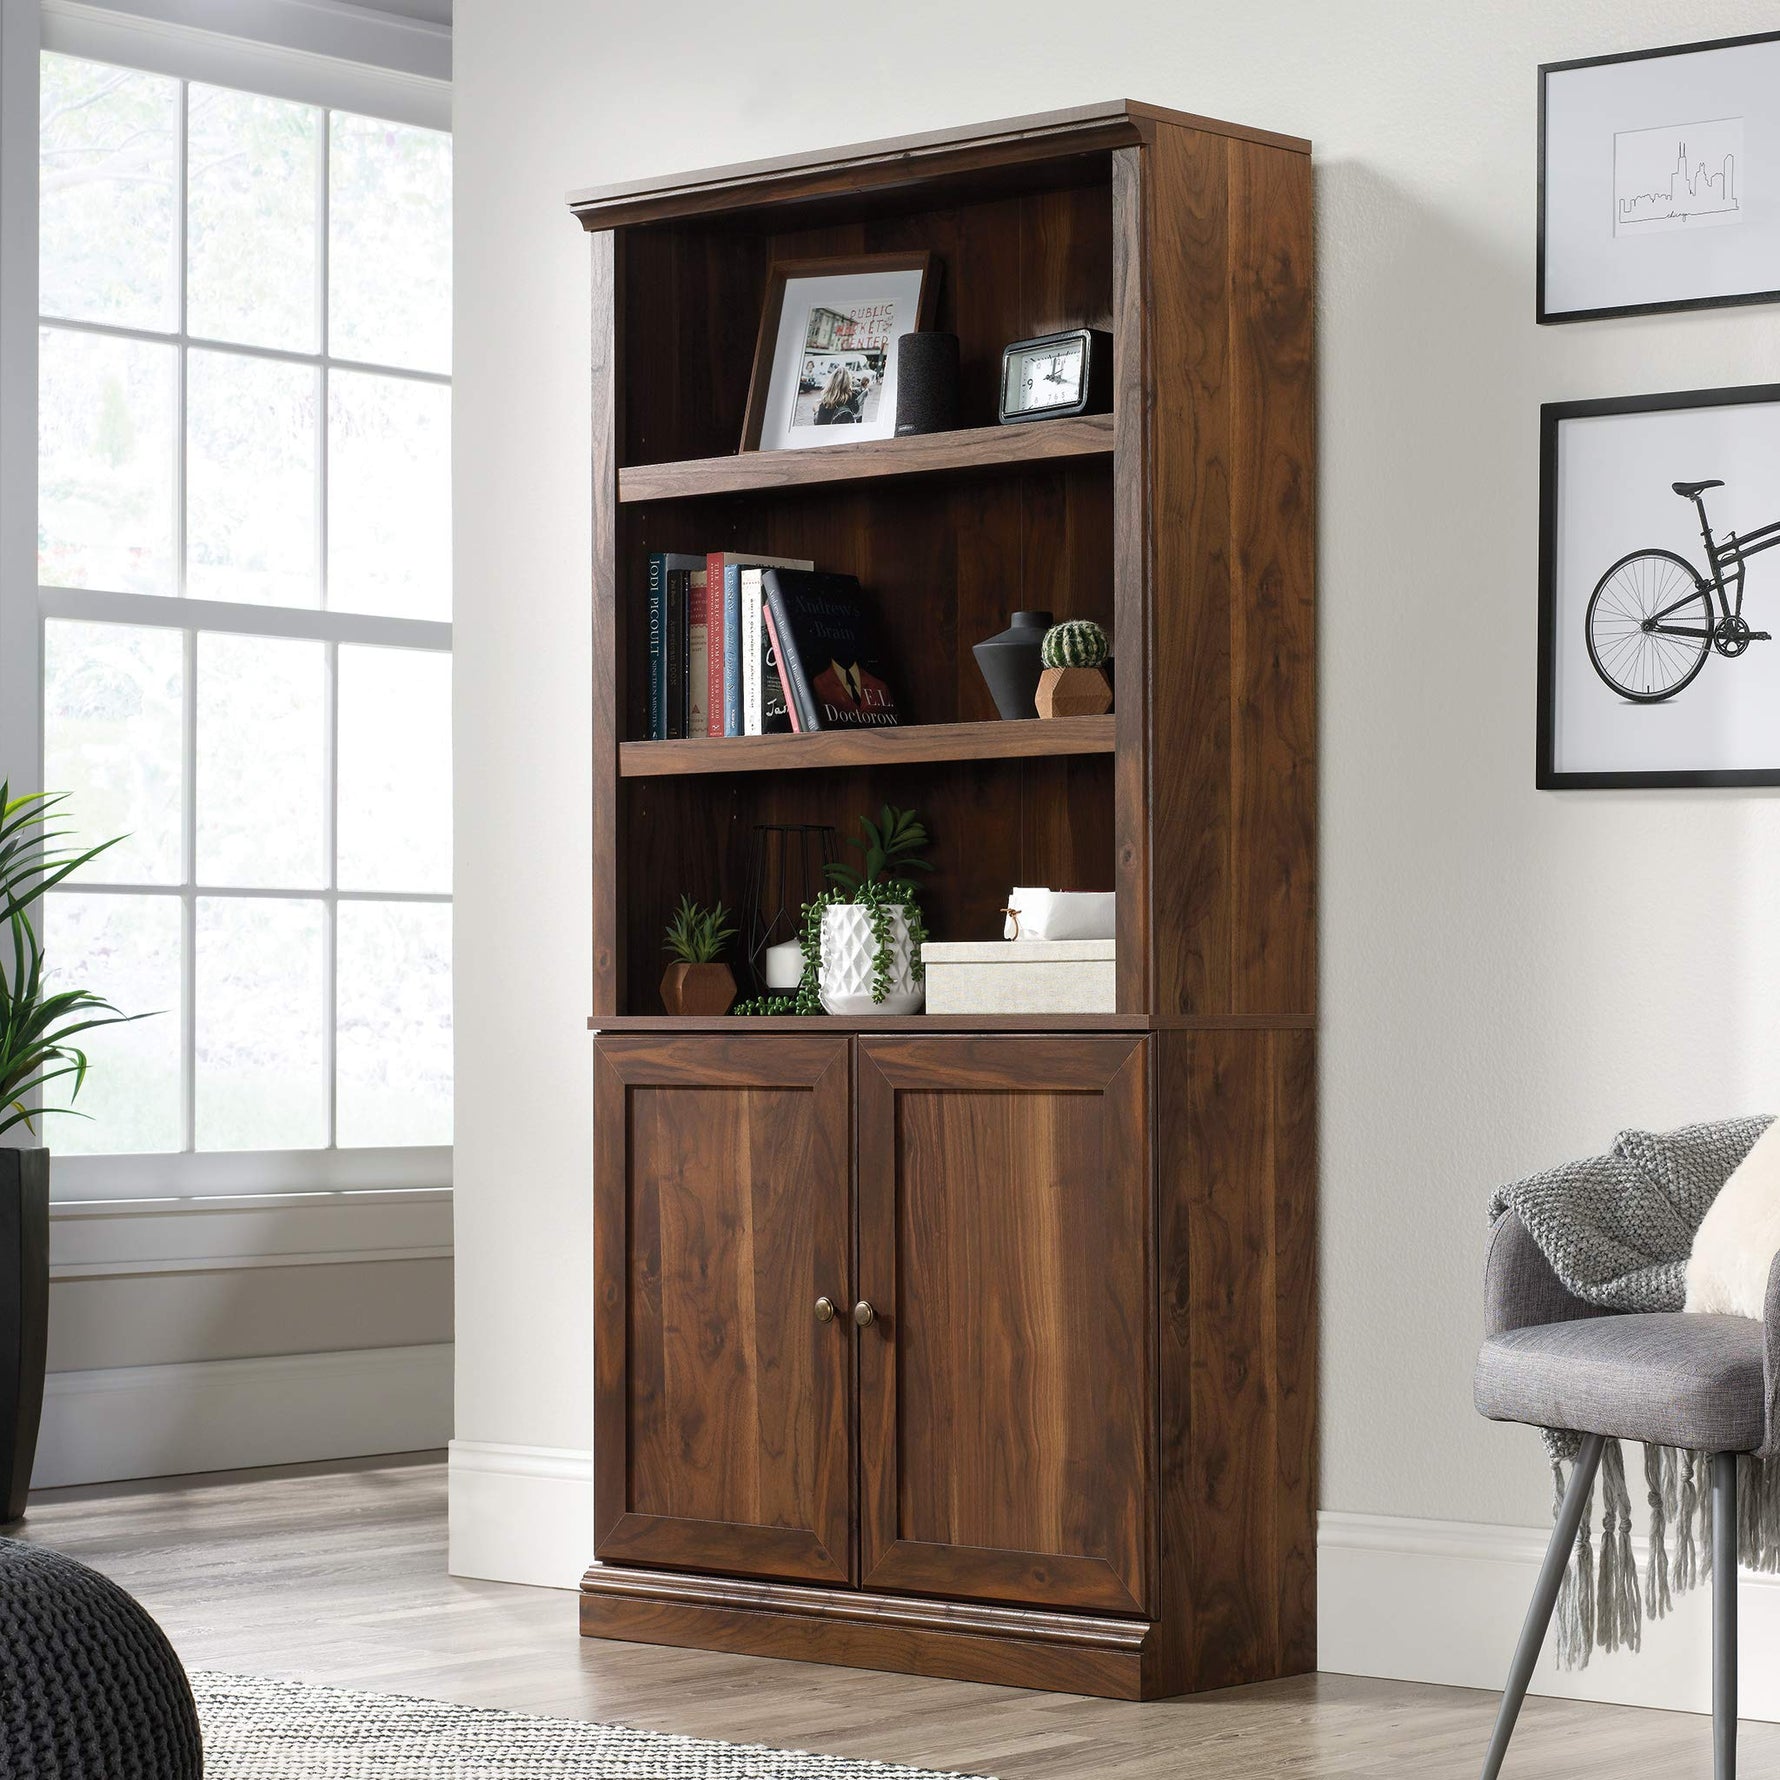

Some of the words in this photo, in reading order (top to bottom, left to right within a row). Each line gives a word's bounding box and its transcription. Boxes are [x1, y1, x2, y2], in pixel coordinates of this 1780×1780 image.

[849, 303, 894, 319] PUBLIC
[1026, 378, 1034, 390] 9
[650, 559, 660, 591] JODI
[650, 597, 660, 657] PICOULT
[778, 620, 788, 641] Brain
[863, 688, 894, 707] E.L.
[824, 703, 899, 726] Doctorow
